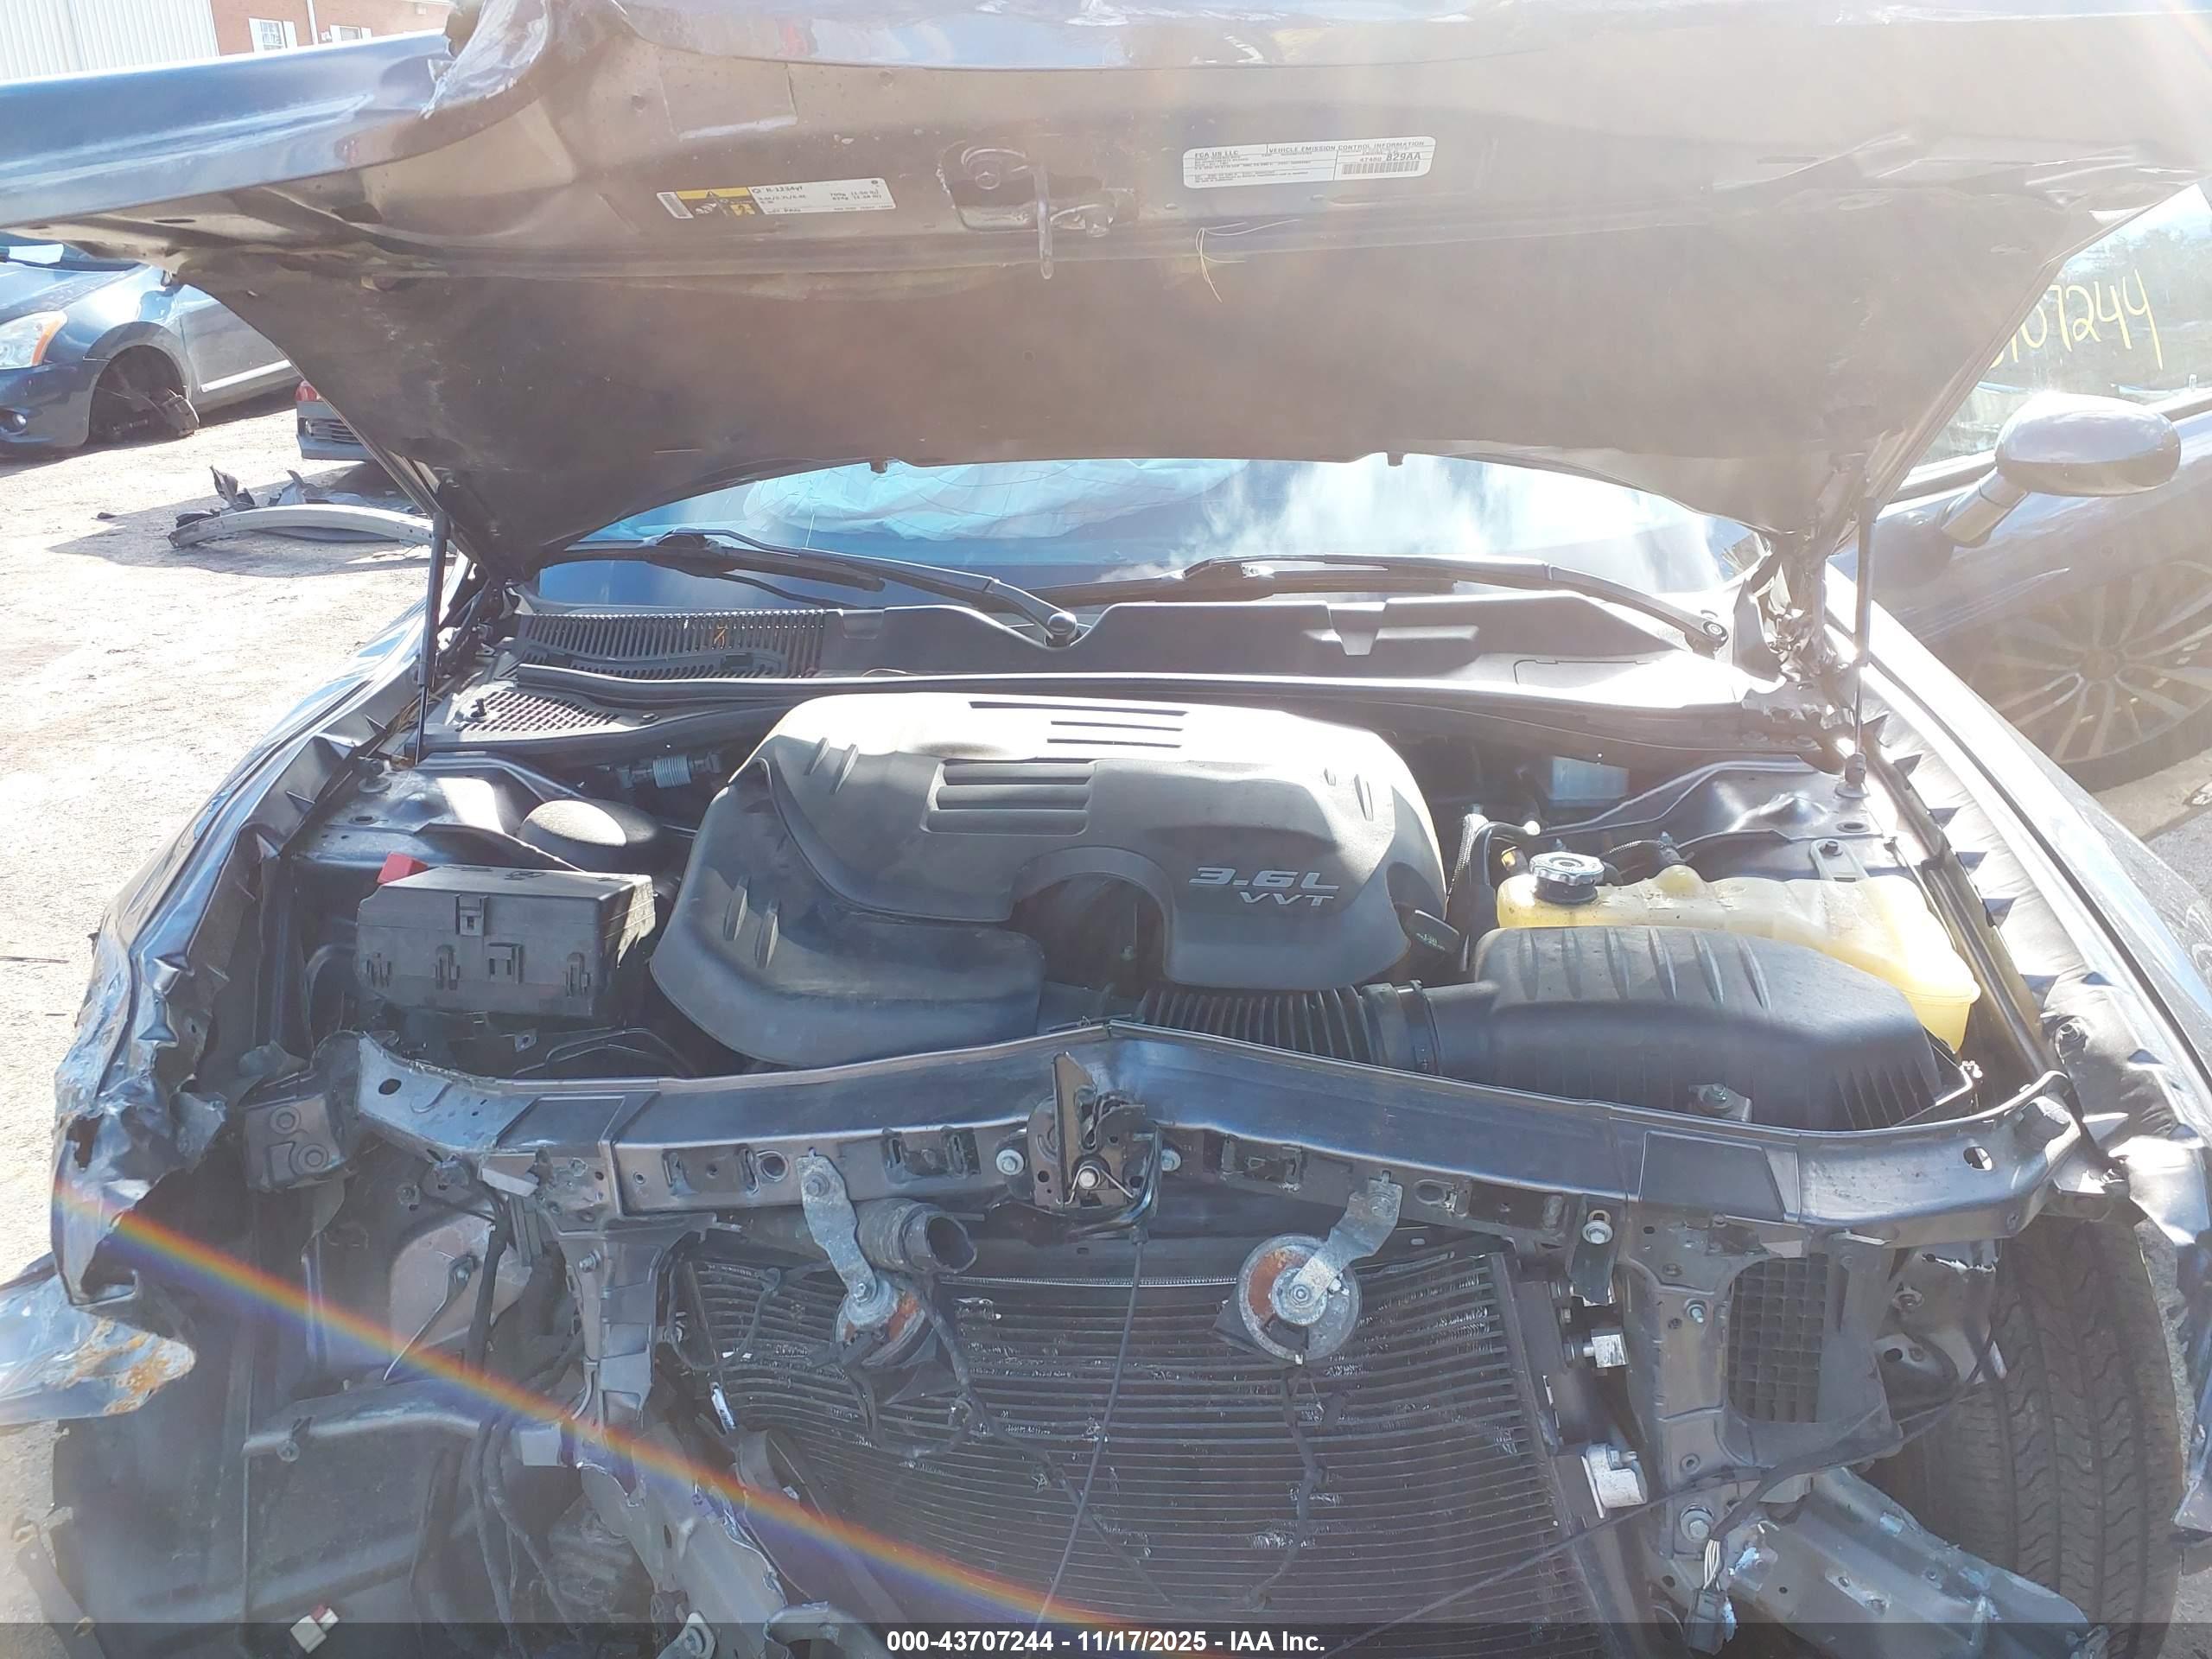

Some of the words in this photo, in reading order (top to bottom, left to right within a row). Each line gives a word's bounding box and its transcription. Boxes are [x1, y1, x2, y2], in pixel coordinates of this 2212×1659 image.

[1338, 143, 1370, 151] CONTROL
[1189, 867, 1340, 890] 3.6L
[1239, 892, 1335, 906] VVT
